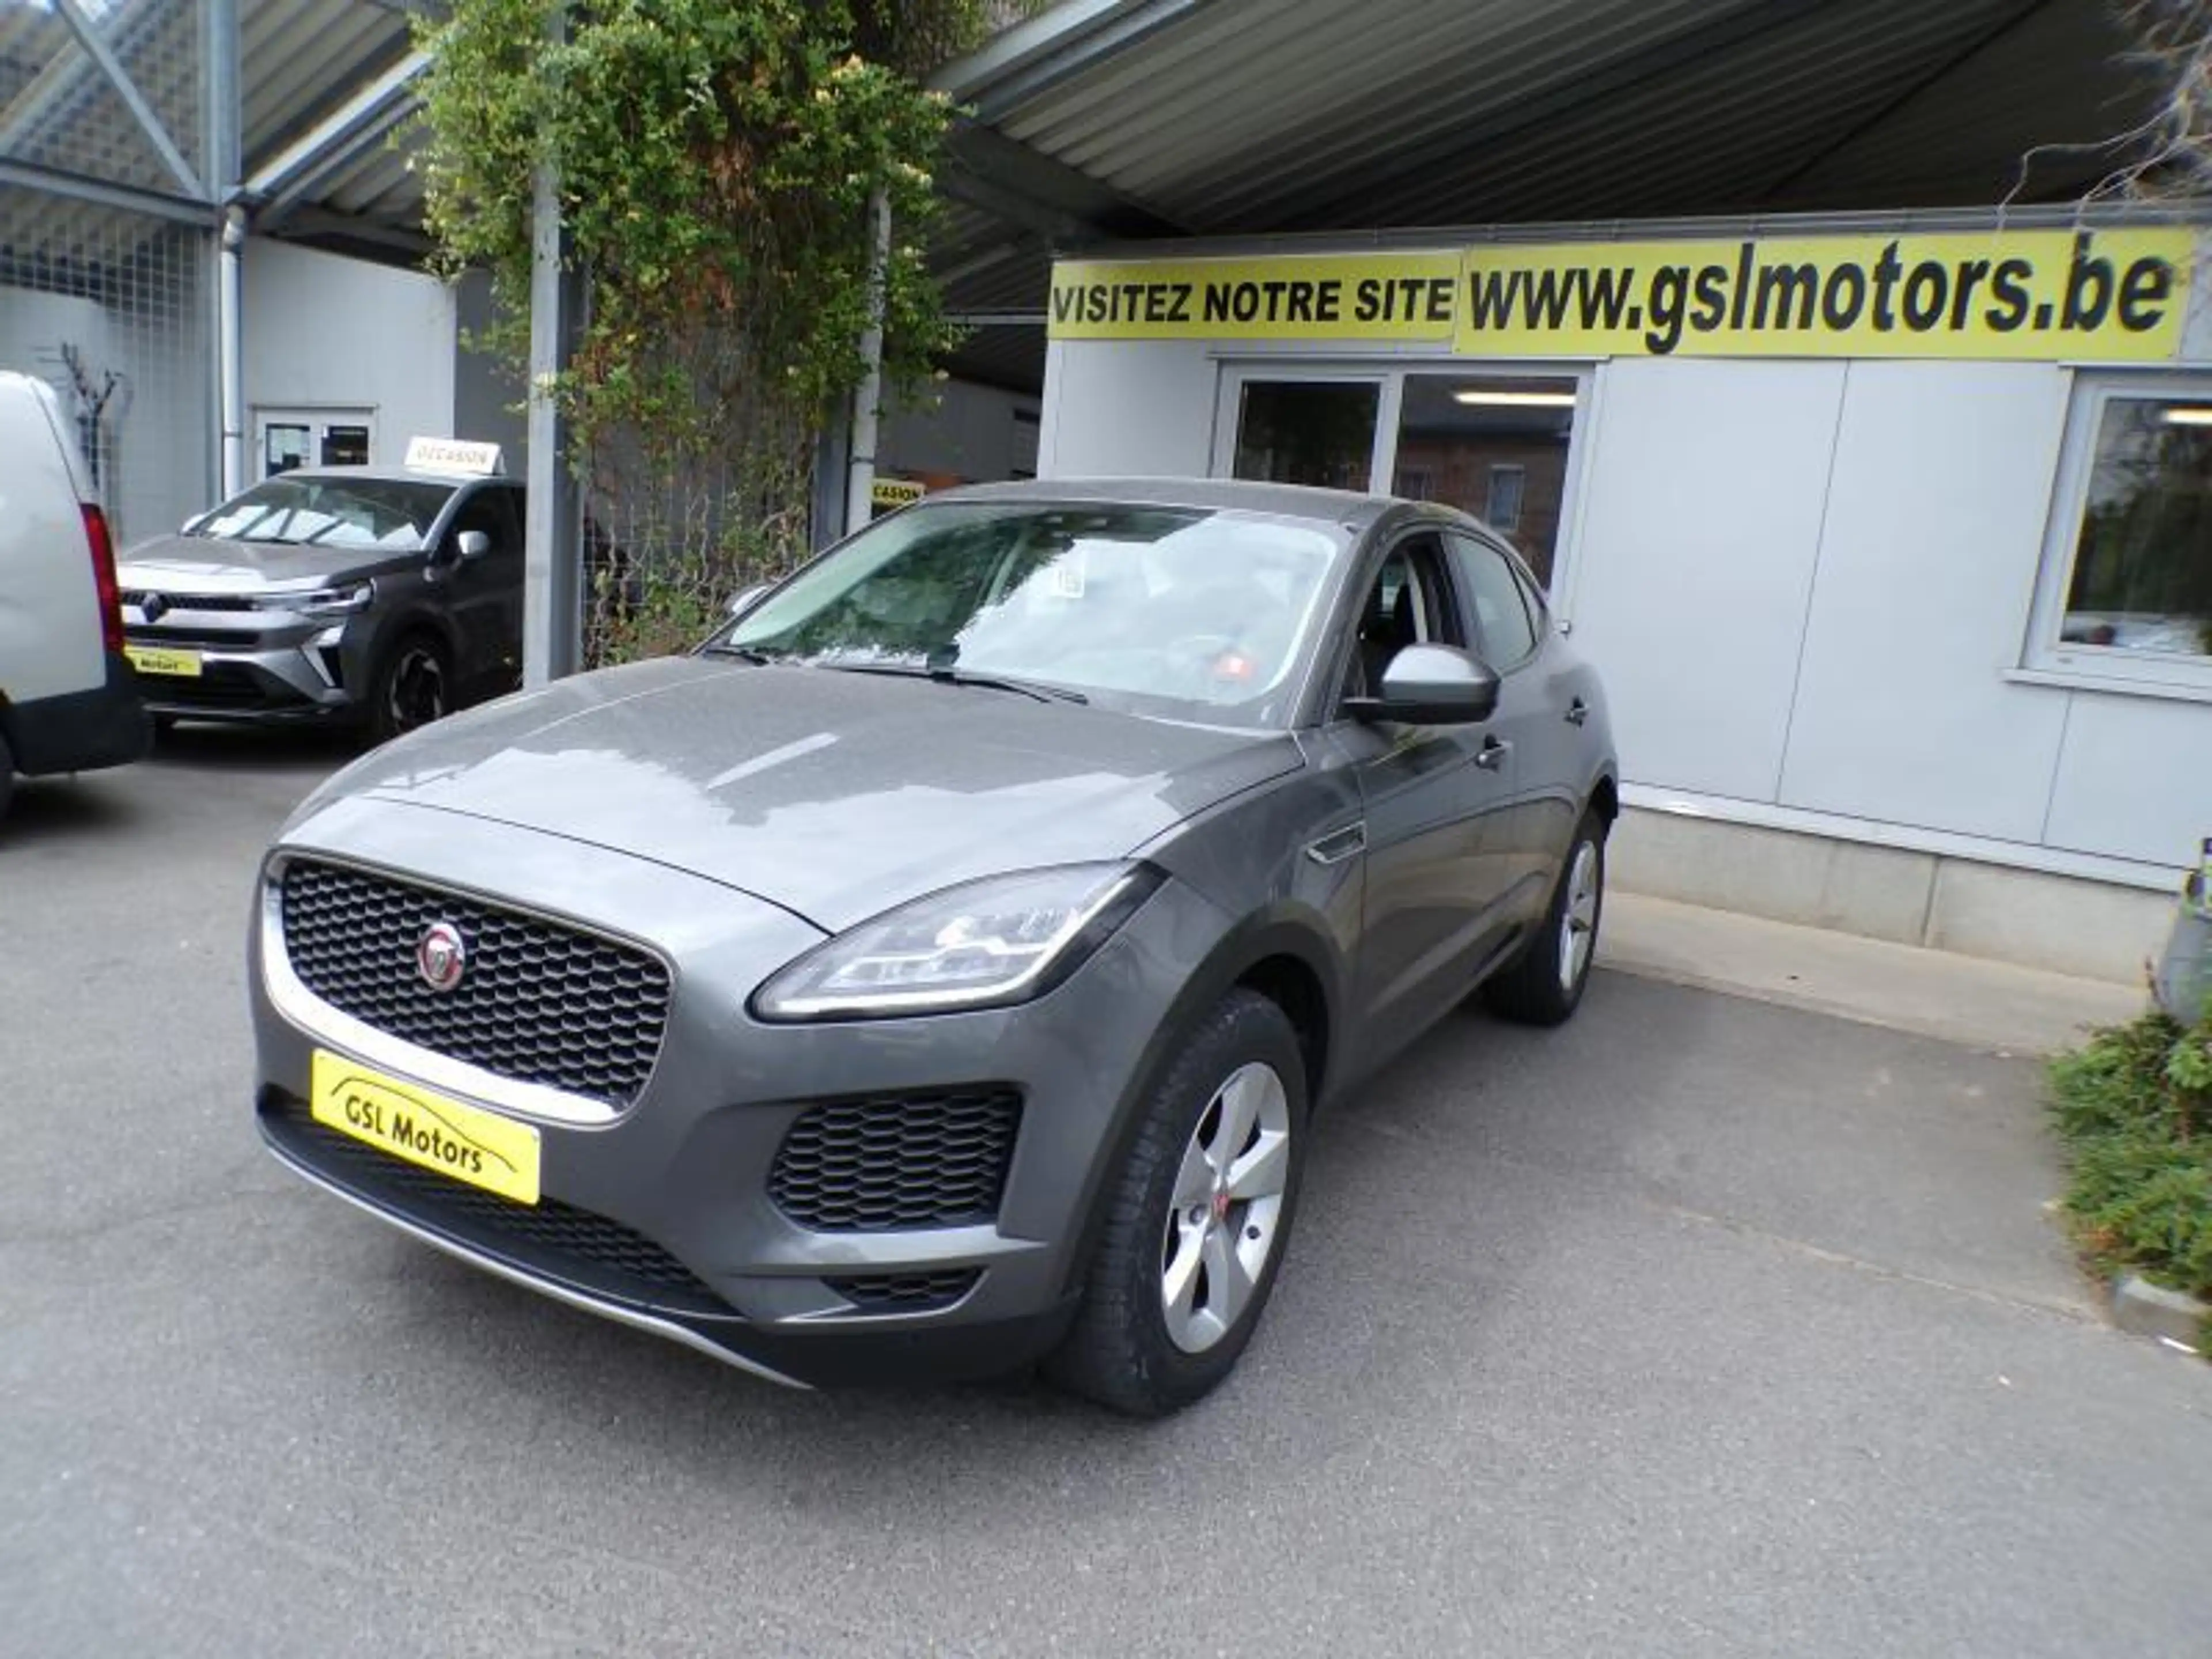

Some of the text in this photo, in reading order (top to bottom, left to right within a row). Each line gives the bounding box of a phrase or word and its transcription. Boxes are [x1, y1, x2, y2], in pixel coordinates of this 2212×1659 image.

[1052, 278, 1455, 323] VISITEZ NOTRE SITE
[1470, 232, 2174, 355] www.gslmotors.be
[346, 1094, 483, 1173] GSL Motors
